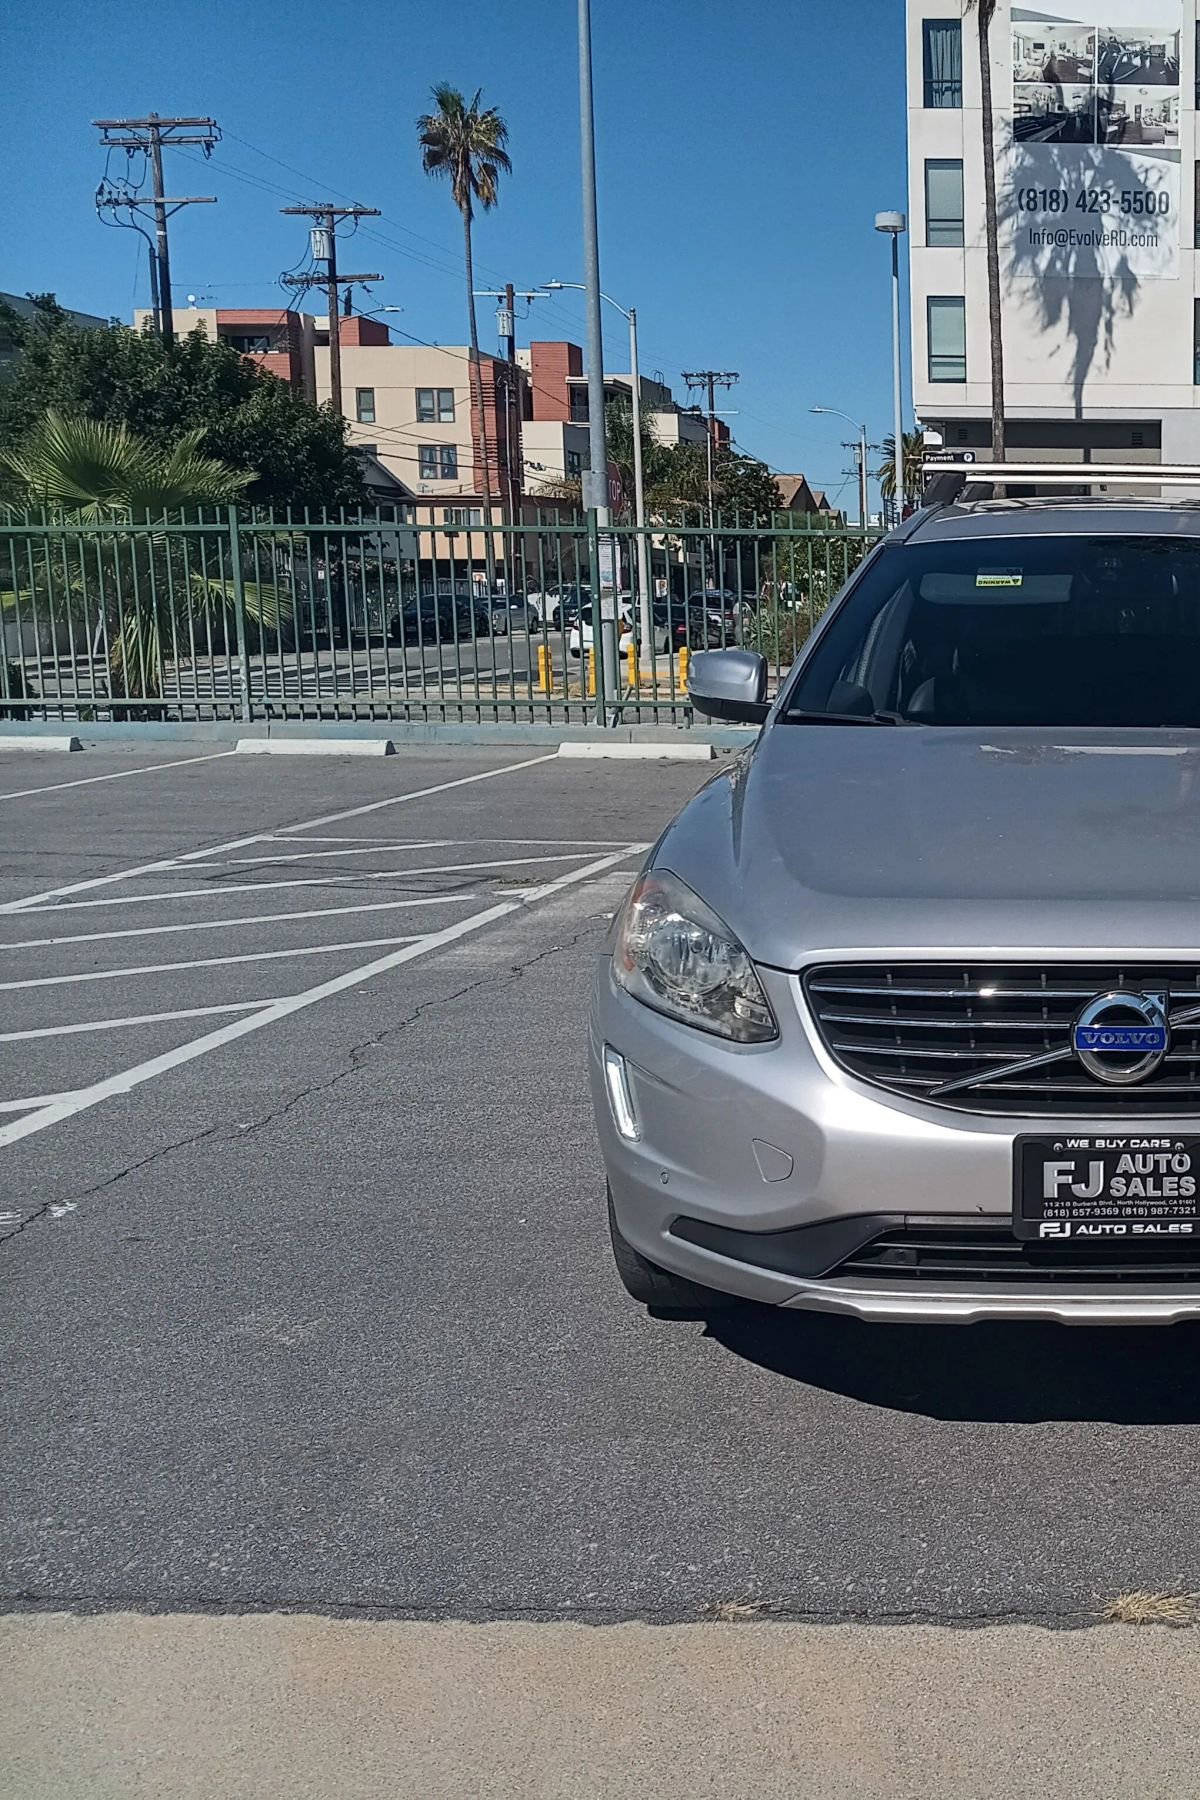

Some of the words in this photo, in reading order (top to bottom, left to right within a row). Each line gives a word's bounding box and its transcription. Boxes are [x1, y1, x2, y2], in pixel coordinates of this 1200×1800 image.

[1018, 188, 1069, 212] (818)
[1075, 190, 1170, 215] 423-5500
[1029, 228, 1158, 247] Info@EvolveRD.com
[925, 454, 954, 462] Payment
[1081, 1032, 1160, 1044] VOLVO
[1066, 1138, 1089, 1148] WE
[1095, 1139, 1127, 1148] BUY
[1130, 1139, 1171, 1148] CARS
[1115, 1153, 1191, 1174] AUTO
[1043, 1160, 1105, 1199] FJ
[1109, 1176, 1196, 1197] SALES
[1043, 1208, 1070, 1218] (818)
[1072, 1207, 1119, 1216] 657-9369
[1121, 1207, 1148, 1217] (818)
[1150, 1206, 1196, 1215] 987-7321
[1040, 1222, 1071, 1238] FJ
[1076, 1224, 1127, 1234] AUTO
[1132, 1223, 1193, 1234] SALES
